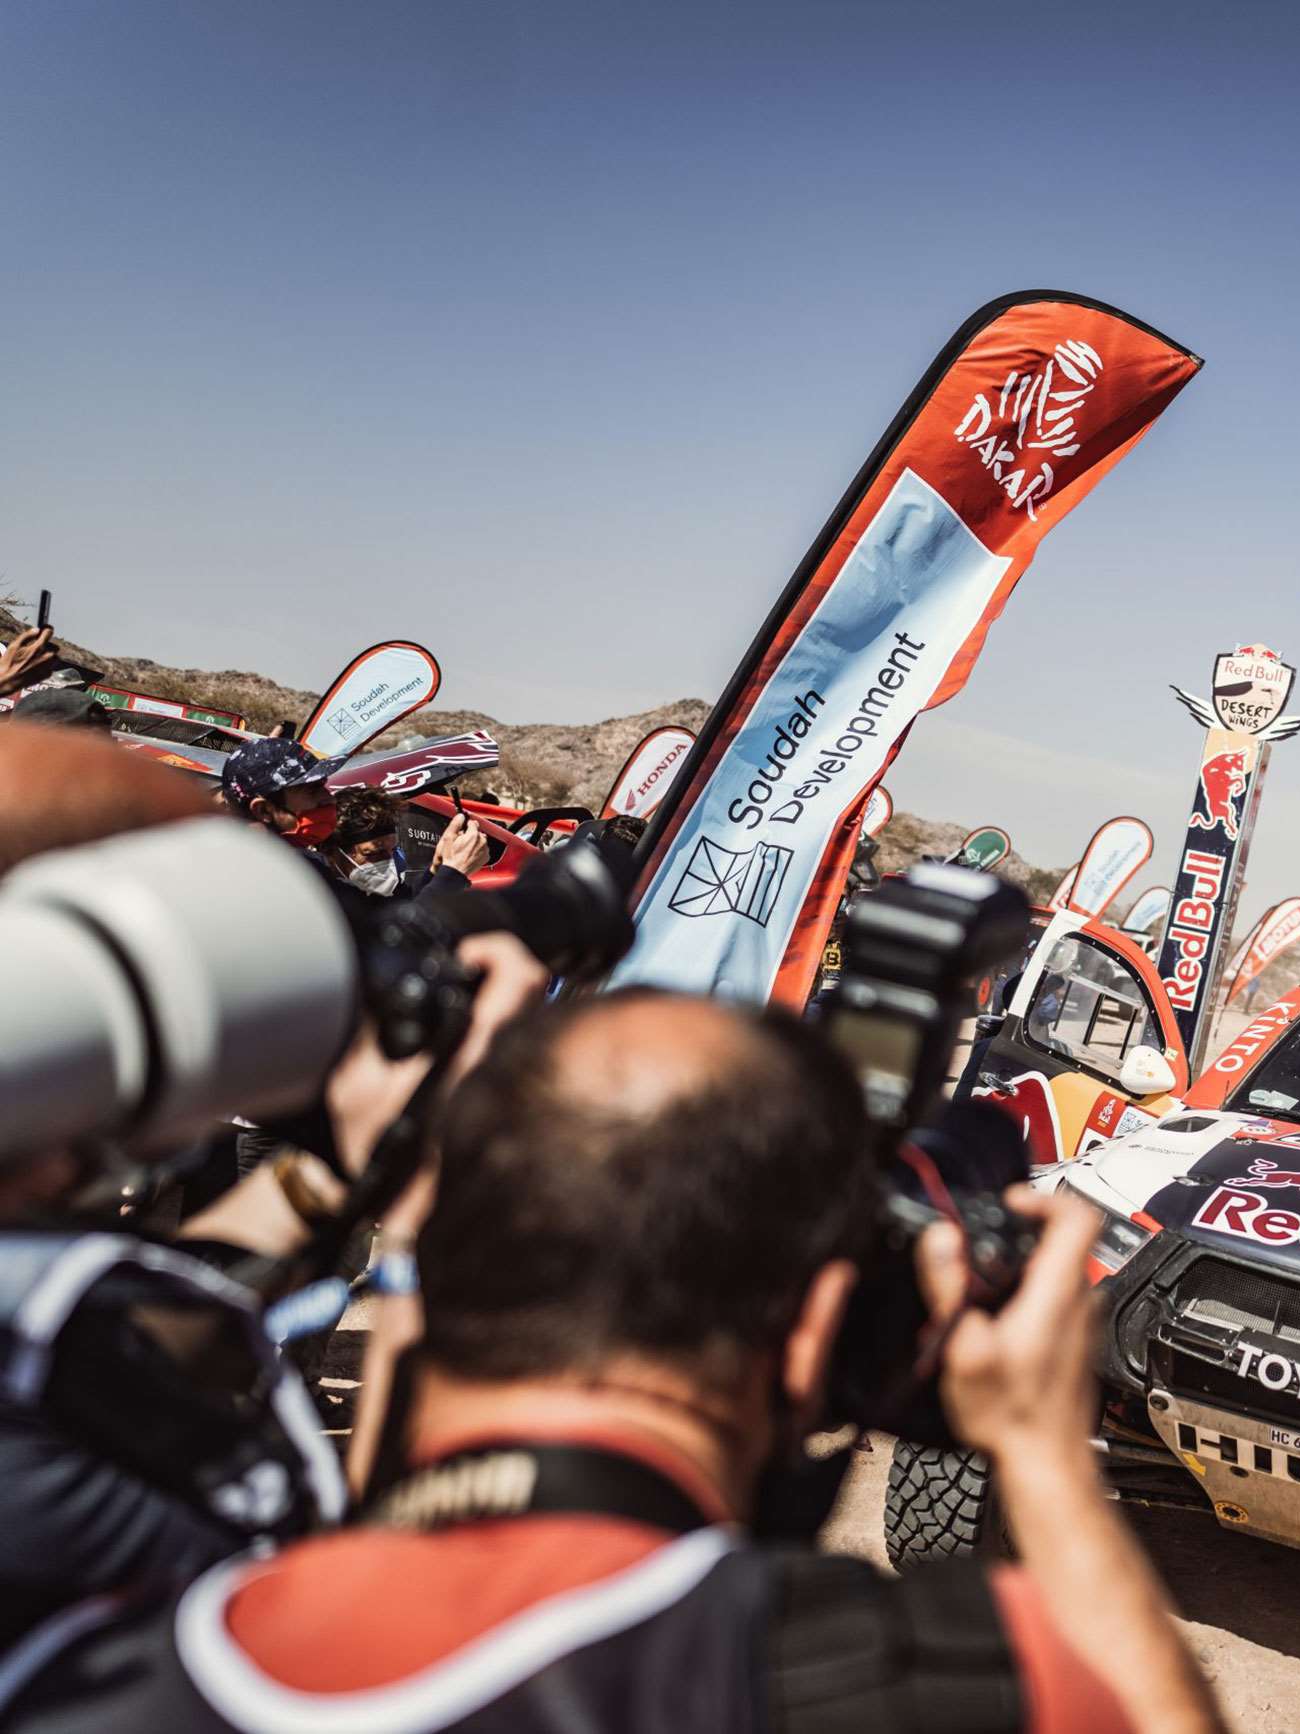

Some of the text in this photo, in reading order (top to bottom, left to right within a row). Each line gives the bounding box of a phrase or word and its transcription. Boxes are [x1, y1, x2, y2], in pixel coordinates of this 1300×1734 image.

[953, 393, 1055, 522] DAKAR
[351, 681, 389, 713] Soudah
[359, 676, 424, 723] Development
[1221, 699, 1273, 719] DESERT
[768, 630, 927, 825] Development
[637, 743, 688, 796] HONDA
[727, 687, 826, 831] Soudah
[1271, 1429, 1289, 1445] HC
